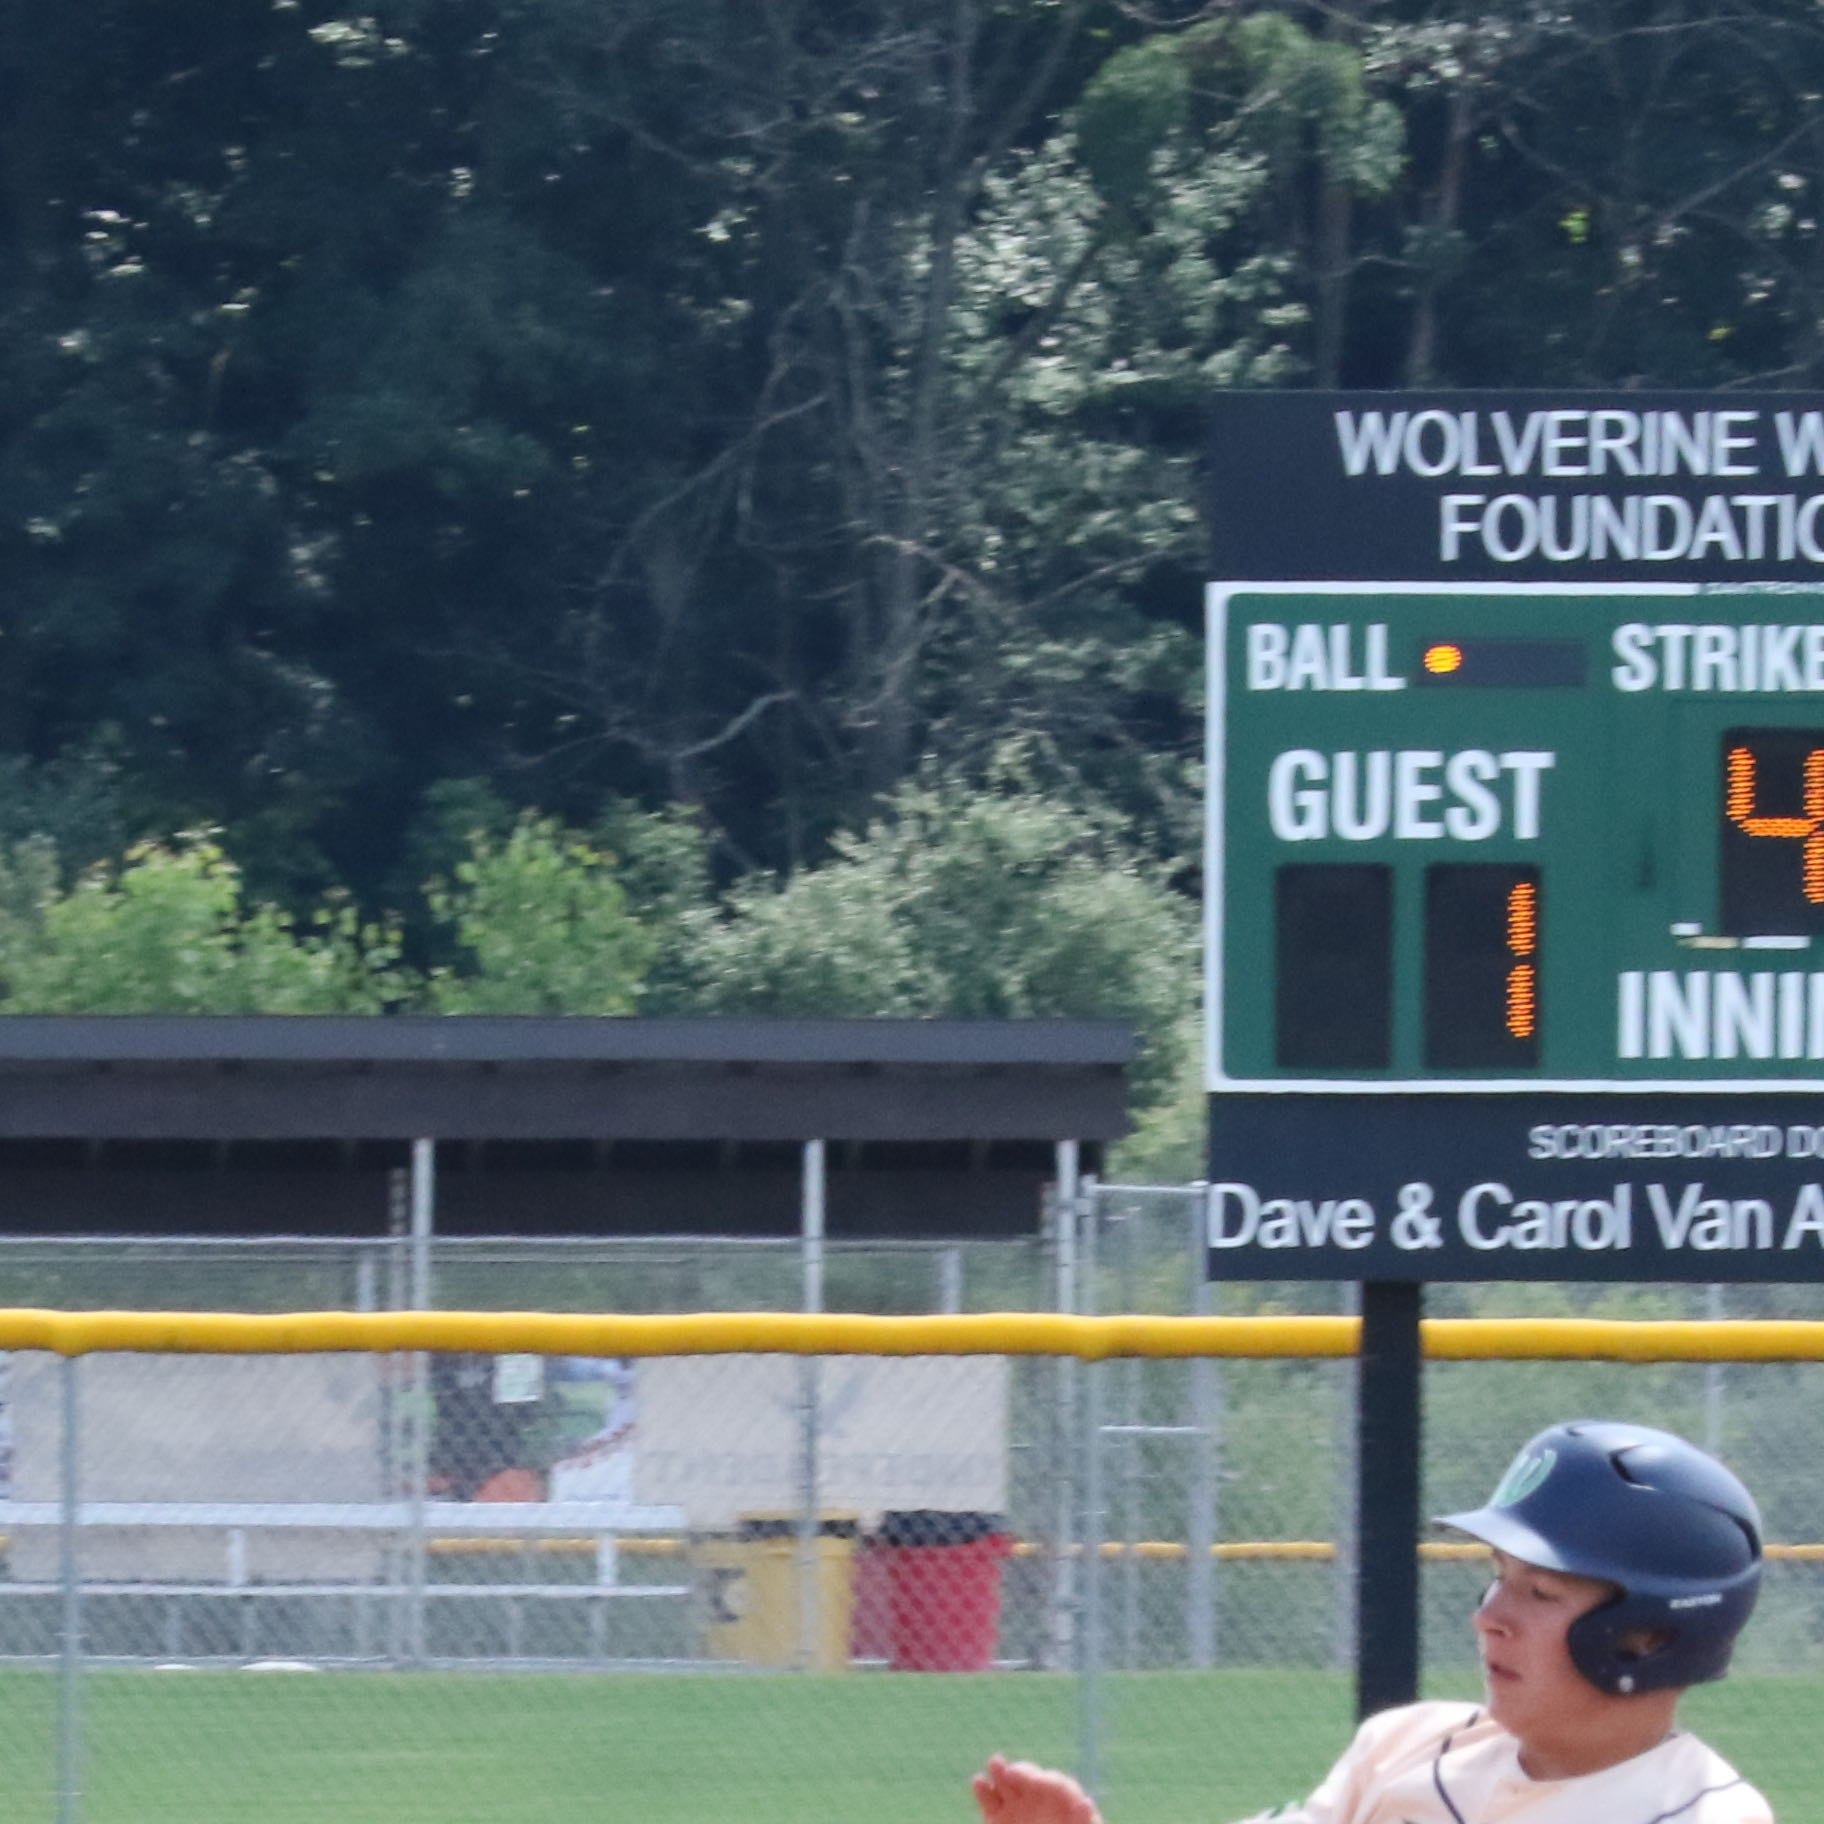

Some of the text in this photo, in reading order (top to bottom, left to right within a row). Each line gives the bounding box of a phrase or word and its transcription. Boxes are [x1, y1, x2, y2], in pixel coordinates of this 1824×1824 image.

[1335, 410, 1758, 476] WOLVERINE
[1247, 623, 1406, 691] BALL
[1268, 749, 1554, 841] GUEST
[1508, 884, 1534, 1037] 1
[1530, 1125, 1782, 1158] SCOREBOARD
[1209, 1183, 1374, 1249] Dave
[1391, 1182, 1442, 1250] &
[1459, 1183, 1631, 1250] Carol
[1647, 1183, 1772, 1250] Van
